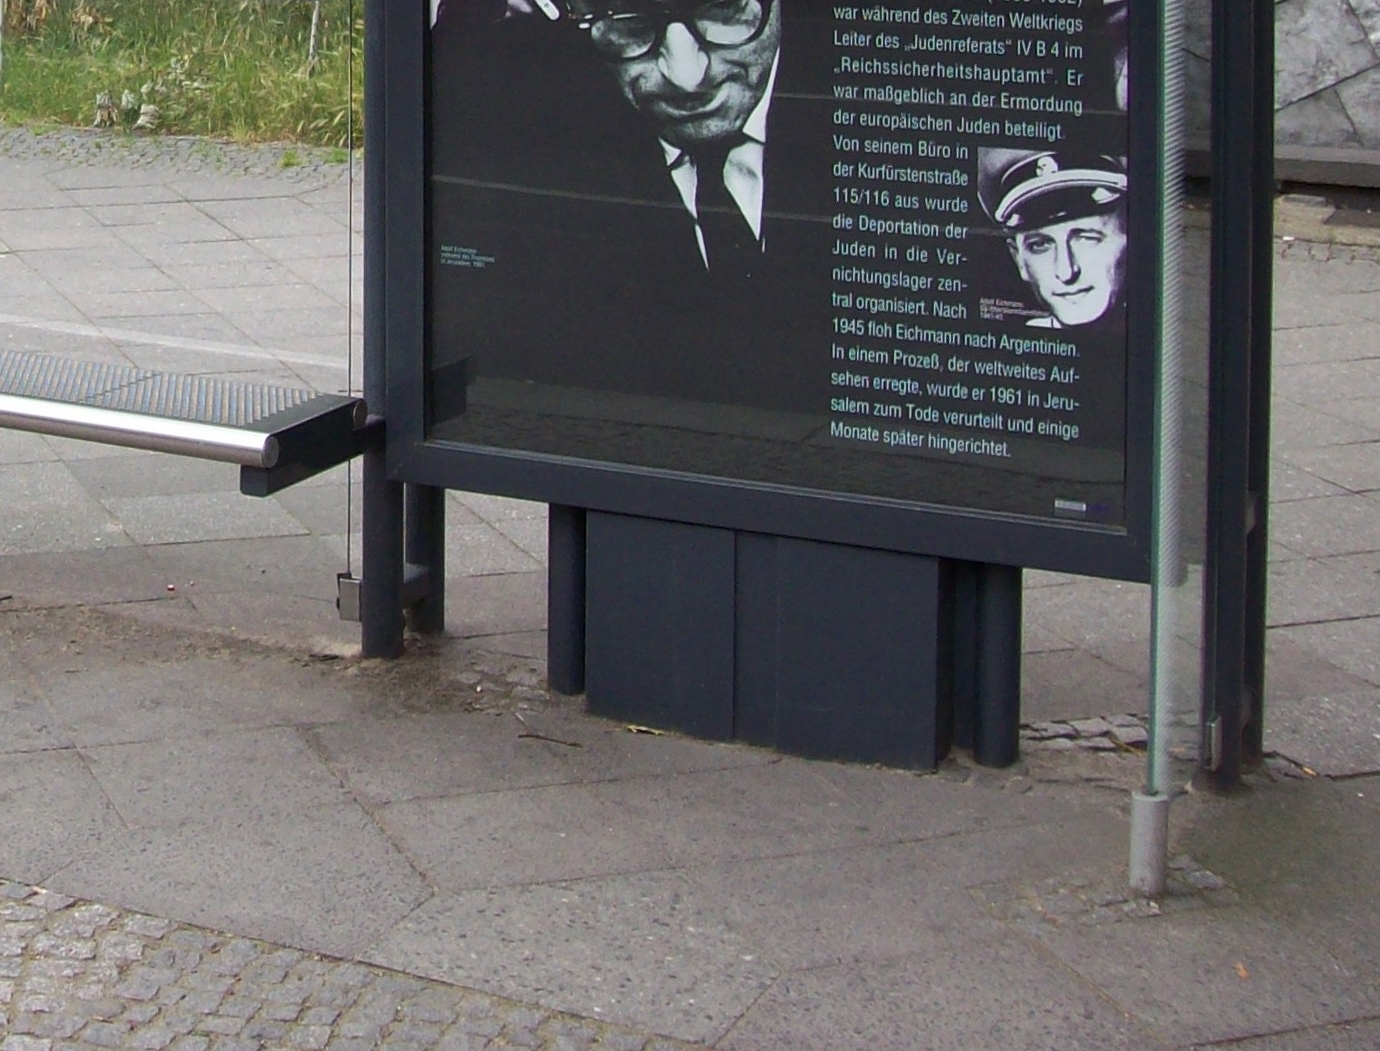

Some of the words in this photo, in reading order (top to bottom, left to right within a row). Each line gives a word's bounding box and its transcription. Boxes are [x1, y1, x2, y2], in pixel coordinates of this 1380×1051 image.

[834, 8, 858, 19] war
[862, 7, 919, 23] während
[924, 9, 947, 24] des
[952, 10, 1005, 27] Zweiten
[1009, 13, 1083, 34] Weltkriegs
[834, 30, 871, 46] Leiter
[876, 33, 899, 48] des
[1018, 40, 1031, 55] IV
[1037, 41, 1045, 56] B
[1051, 42, 1059, 57] 4
[1065, 43, 1082, 58] im
[1068, 70, 1083, 85] Er
[834, 86, 858, 99] war
[864, 86, 944, 105] maßgeblich
[950, 93, 966, 105] an
[972, 92, 995, 107] der
[1001, 92, 1082, 116] Ermordung
[834, 109, 855, 124] der
[860, 113, 952, 131] europäischen
[957, 117, 999, 134] Juden
[833, 135, 859, 151] Von
[865, 140, 912, 155] seinem
[919, 140, 950, 158] Büro
[956, 144, 968, 159] in
[833, 161, 854, 176] der
[858, 163, 968, 186] Kurfürstenstraße
[834, 187, 889, 206] 115/116
[895, 195, 919, 208] aus
[925, 197, 968, 212] wurde
[833, 213, 853, 229] die
[859, 215, 939, 236] Deportation
[945, 223, 968, 239] der
[833, 239, 875, 257] Juden
[885, 244, 897, 259] in
[907, 246, 927, 262] die
[937, 248, 967, 265] Ver-
[833, 266, 932, 291] nichtungslager
[938, 278, 967, 291] zen-
[832, 292, 852, 307] tral
[856, 297, 928, 315] organisiert.
[933, 301, 966, 318] Nach
[833, 317, 864, 335] 1945
[868, 321, 892, 338] floh
[896, 324, 960, 345] Eichmann
[965, 333, 996, 348] nach
[1000, 334, 1080, 357] Argentinien.
[832, 343, 844, 359] In
[849, 346, 888, 363] einem
[894, 349, 942, 371] Prozeß,
[948, 356, 970, 372] der
[974, 361, 1045, 380] weltweites
[1050, 366, 1079, 383] Auf-
[831, 371, 869, 388] sehen
[873, 377, 922, 395] erregte,
[927, 383, 968, 399] wurde
[972, 388, 985, 400] er
[990, 387, 1021, 404] 1961
[1028, 391, 1039, 406] in
[1044, 393, 1079, 410] Jeru-
[831, 397, 869, 414] salem
[874, 403, 901, 418] zum
[906, 404, 939, 422] Tode
[943, 408, 1003, 429] verurteilt
[1008, 418, 1033, 433] und
[1038, 421, 1079, 440] einige
[831, 421, 879, 441] Monate
[883, 430, 924, 446] später
[928, 433, 1011, 457] hingerichtet.
